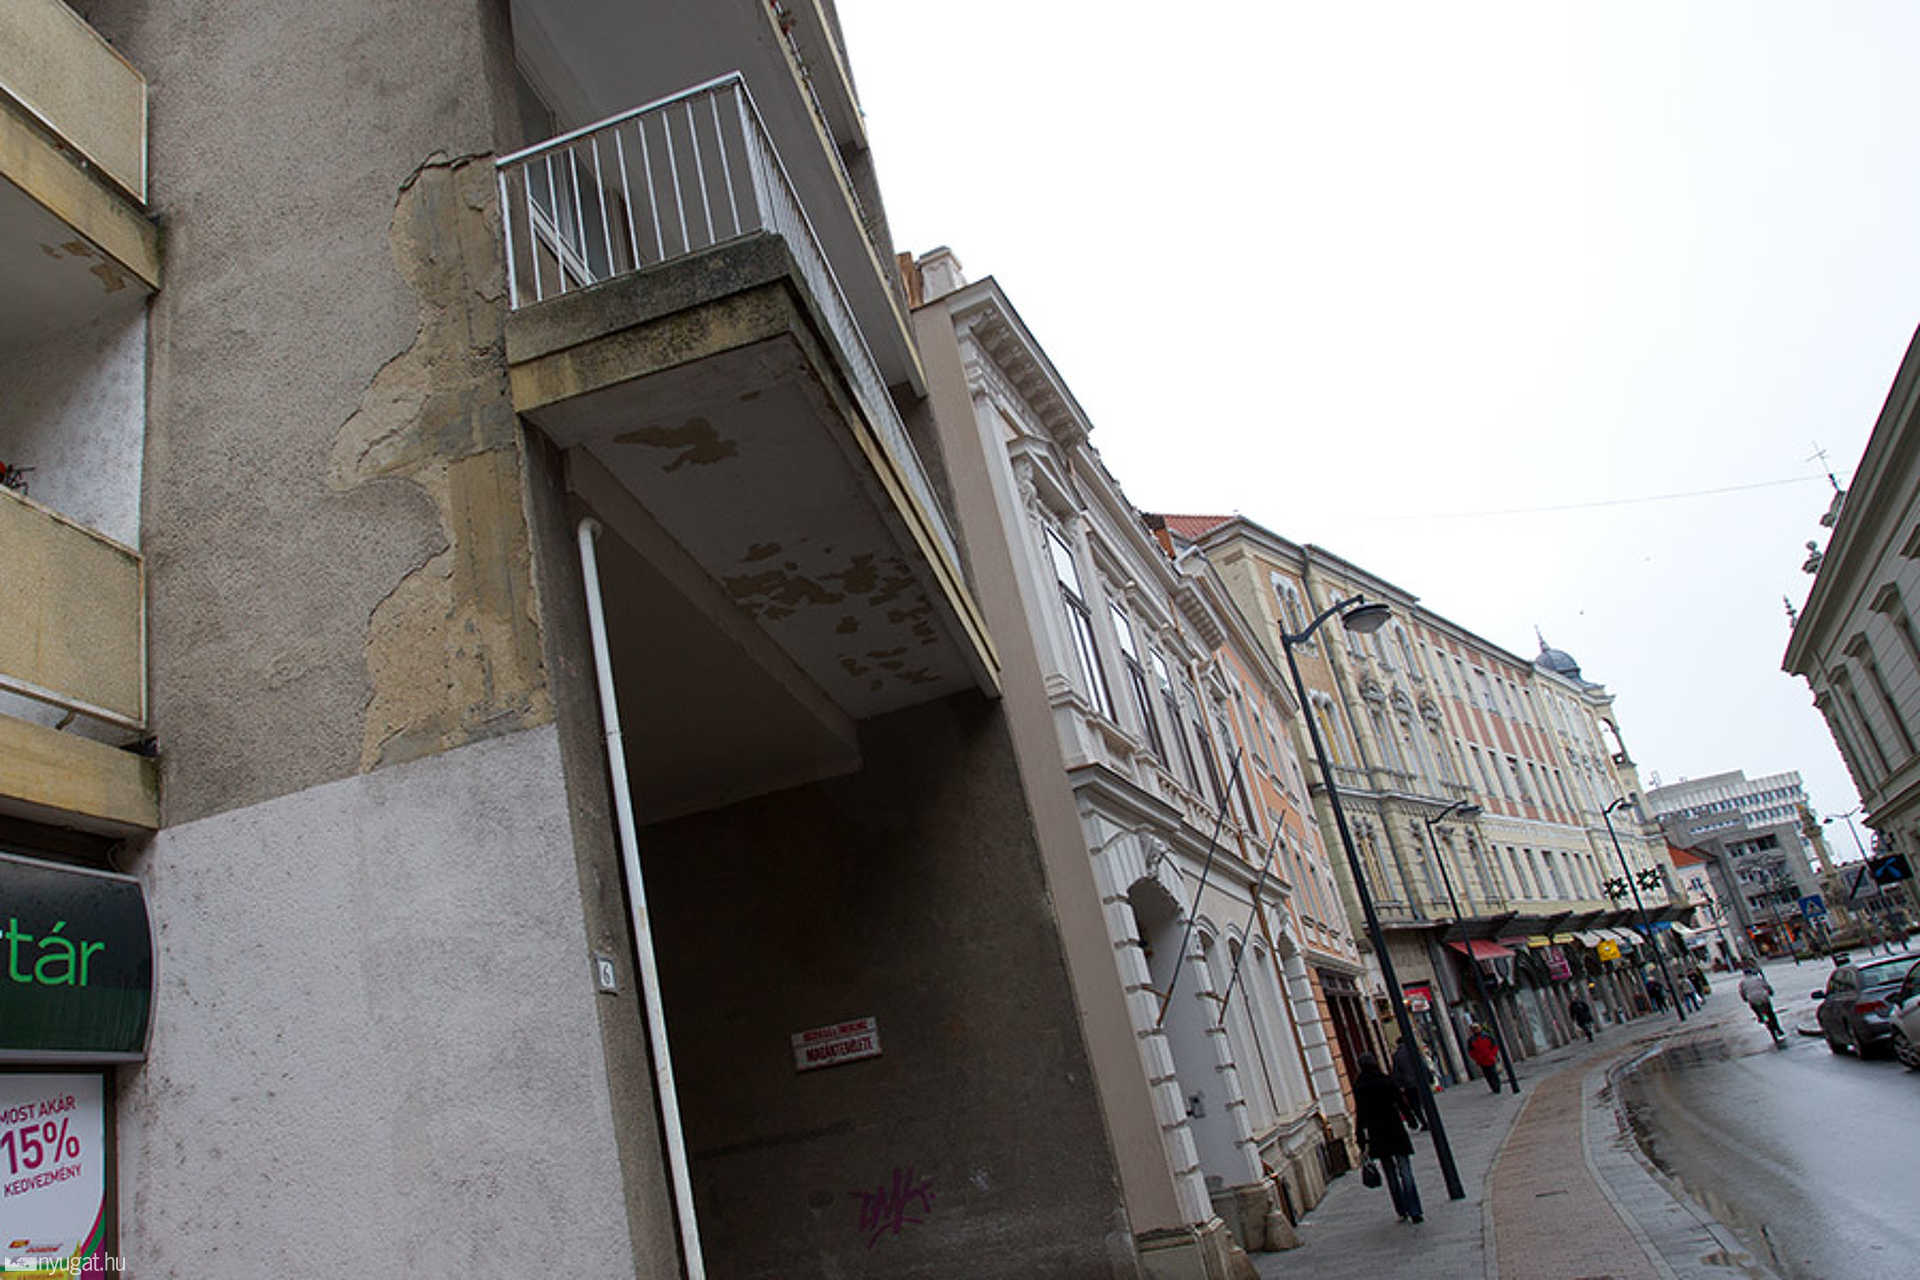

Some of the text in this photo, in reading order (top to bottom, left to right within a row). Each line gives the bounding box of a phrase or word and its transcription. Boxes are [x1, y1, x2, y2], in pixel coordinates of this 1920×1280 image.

[0, 917, 105, 986] tár
[0, 1092, 77, 1125] MOST AKÁR
[0, 1117, 81, 1175] 15%
[4, 1163, 82, 1198] KEDVEZMÉNY
